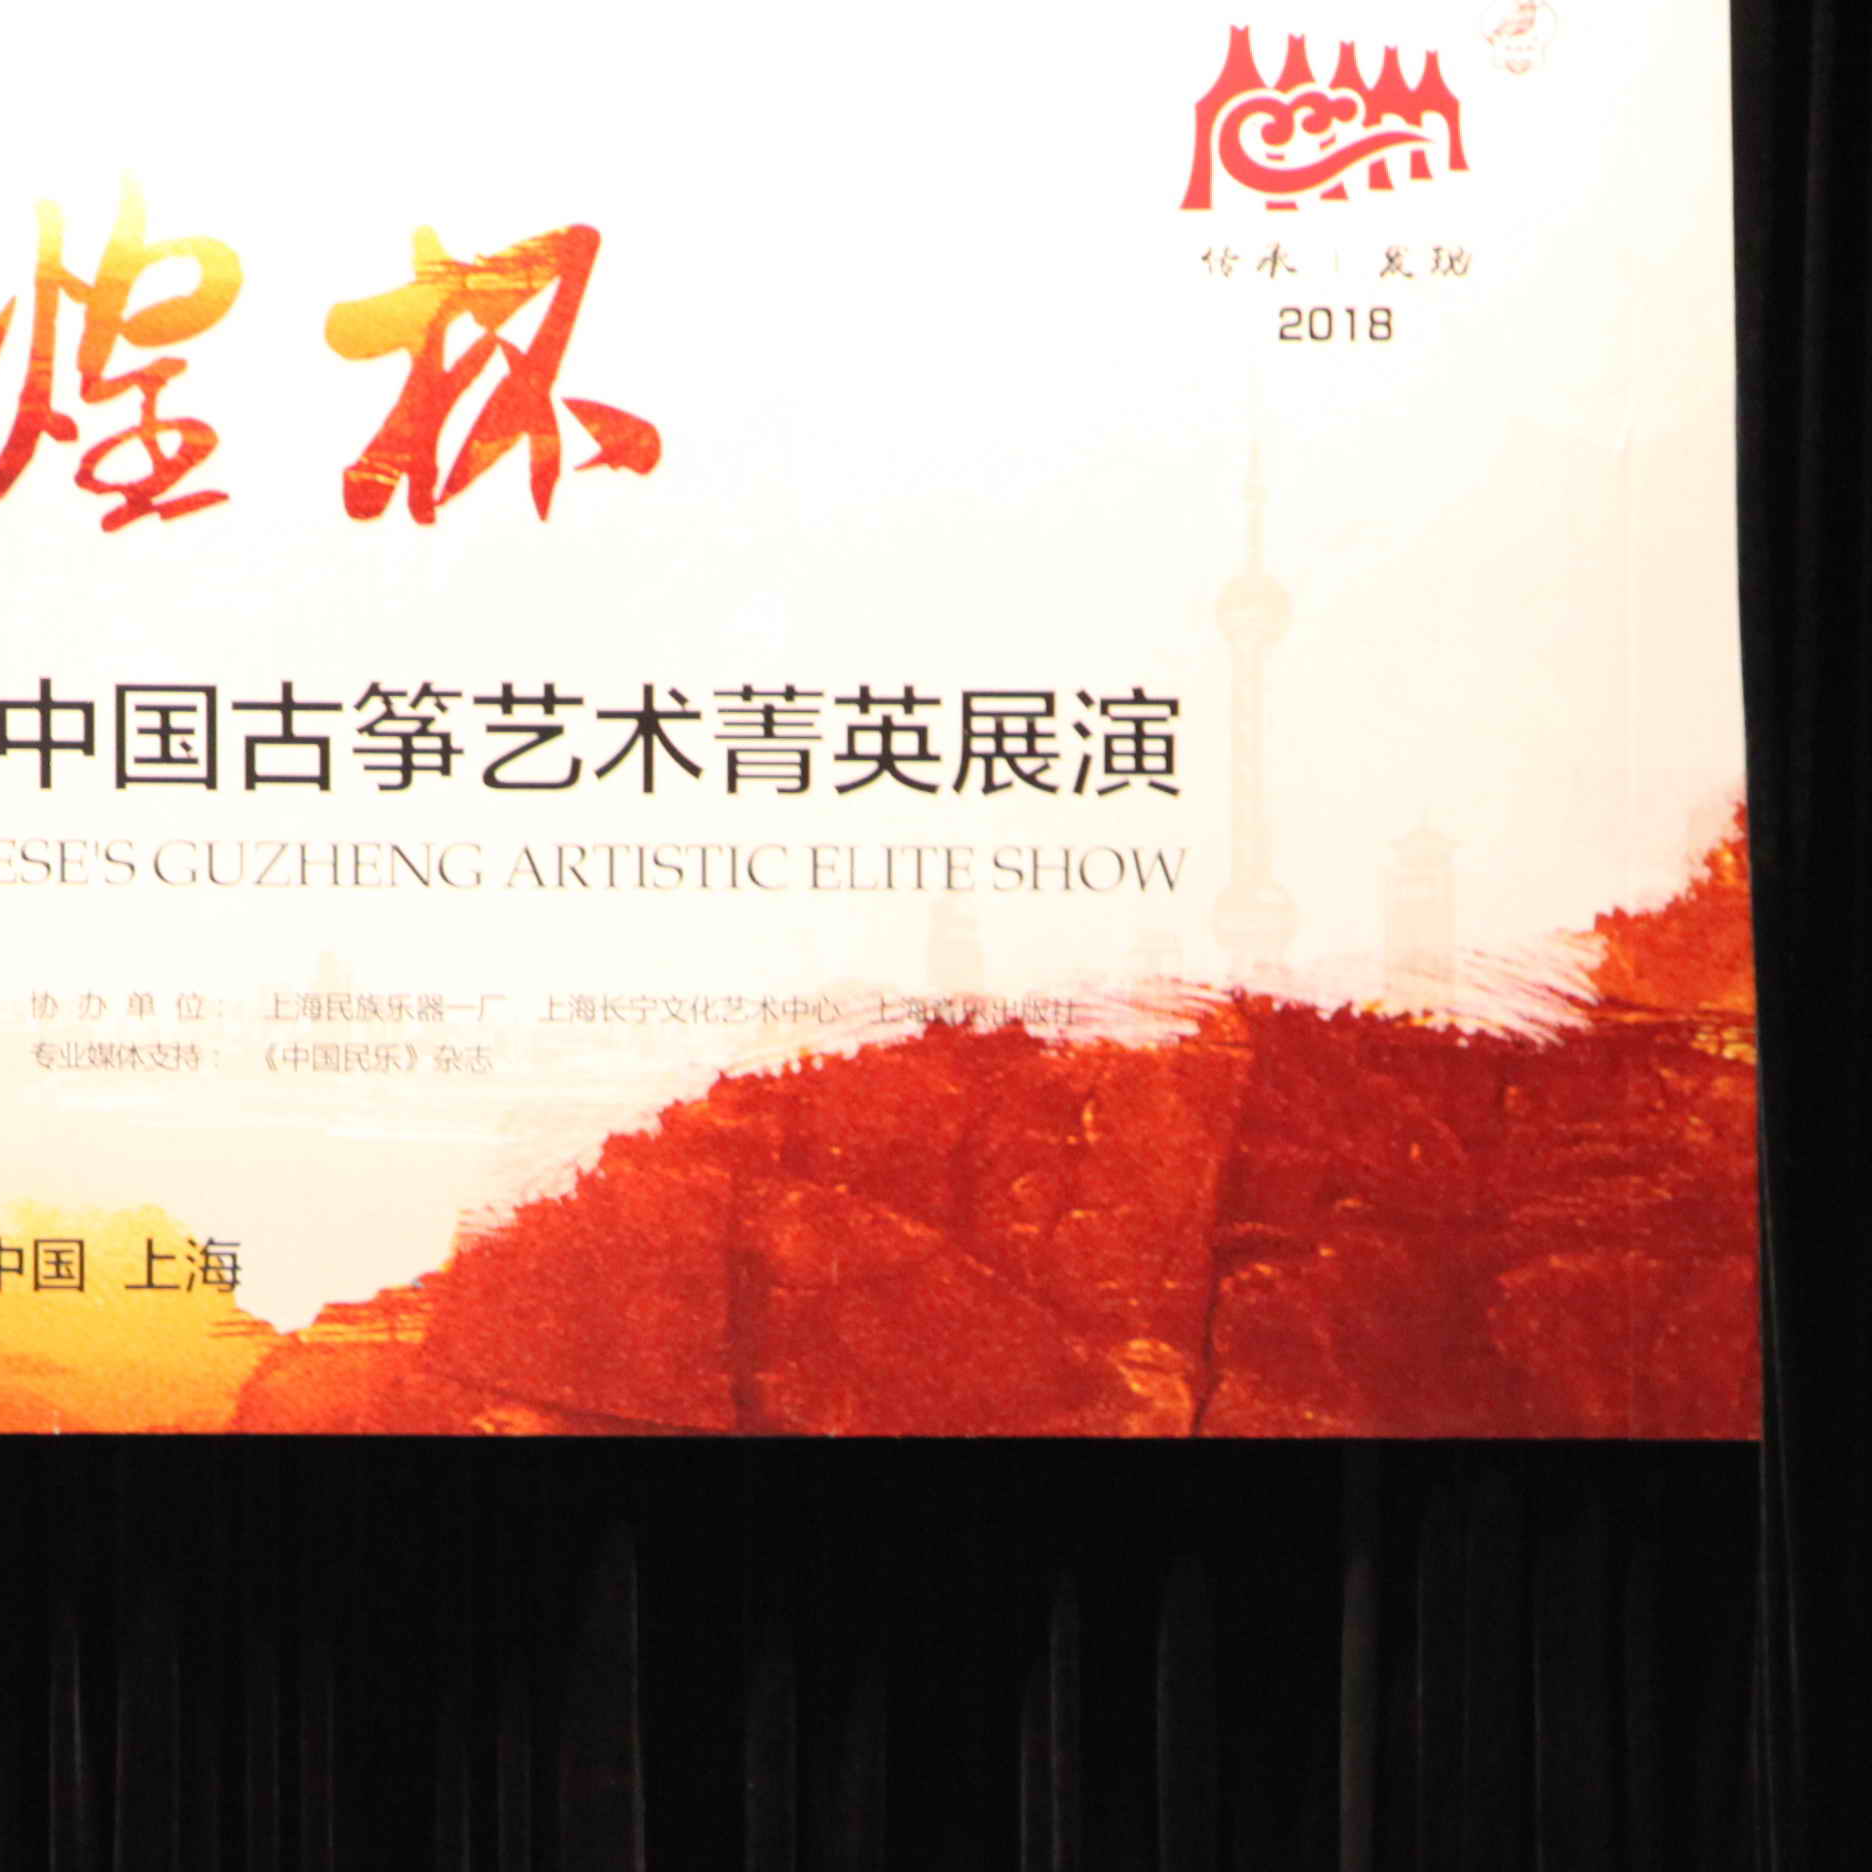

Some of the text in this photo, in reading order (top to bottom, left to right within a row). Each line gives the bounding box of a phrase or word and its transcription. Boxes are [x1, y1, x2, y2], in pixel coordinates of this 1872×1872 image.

[1278, 306, 1394, 342] 2018
[153, 838, 482, 888] GUZHENG
[505, 842, 789, 892] ARTISTIC
[807, 843, 975, 893] ELITE
[992, 844, 1190, 894] SHOW
[125, 1237, 241, 1293] 上海
